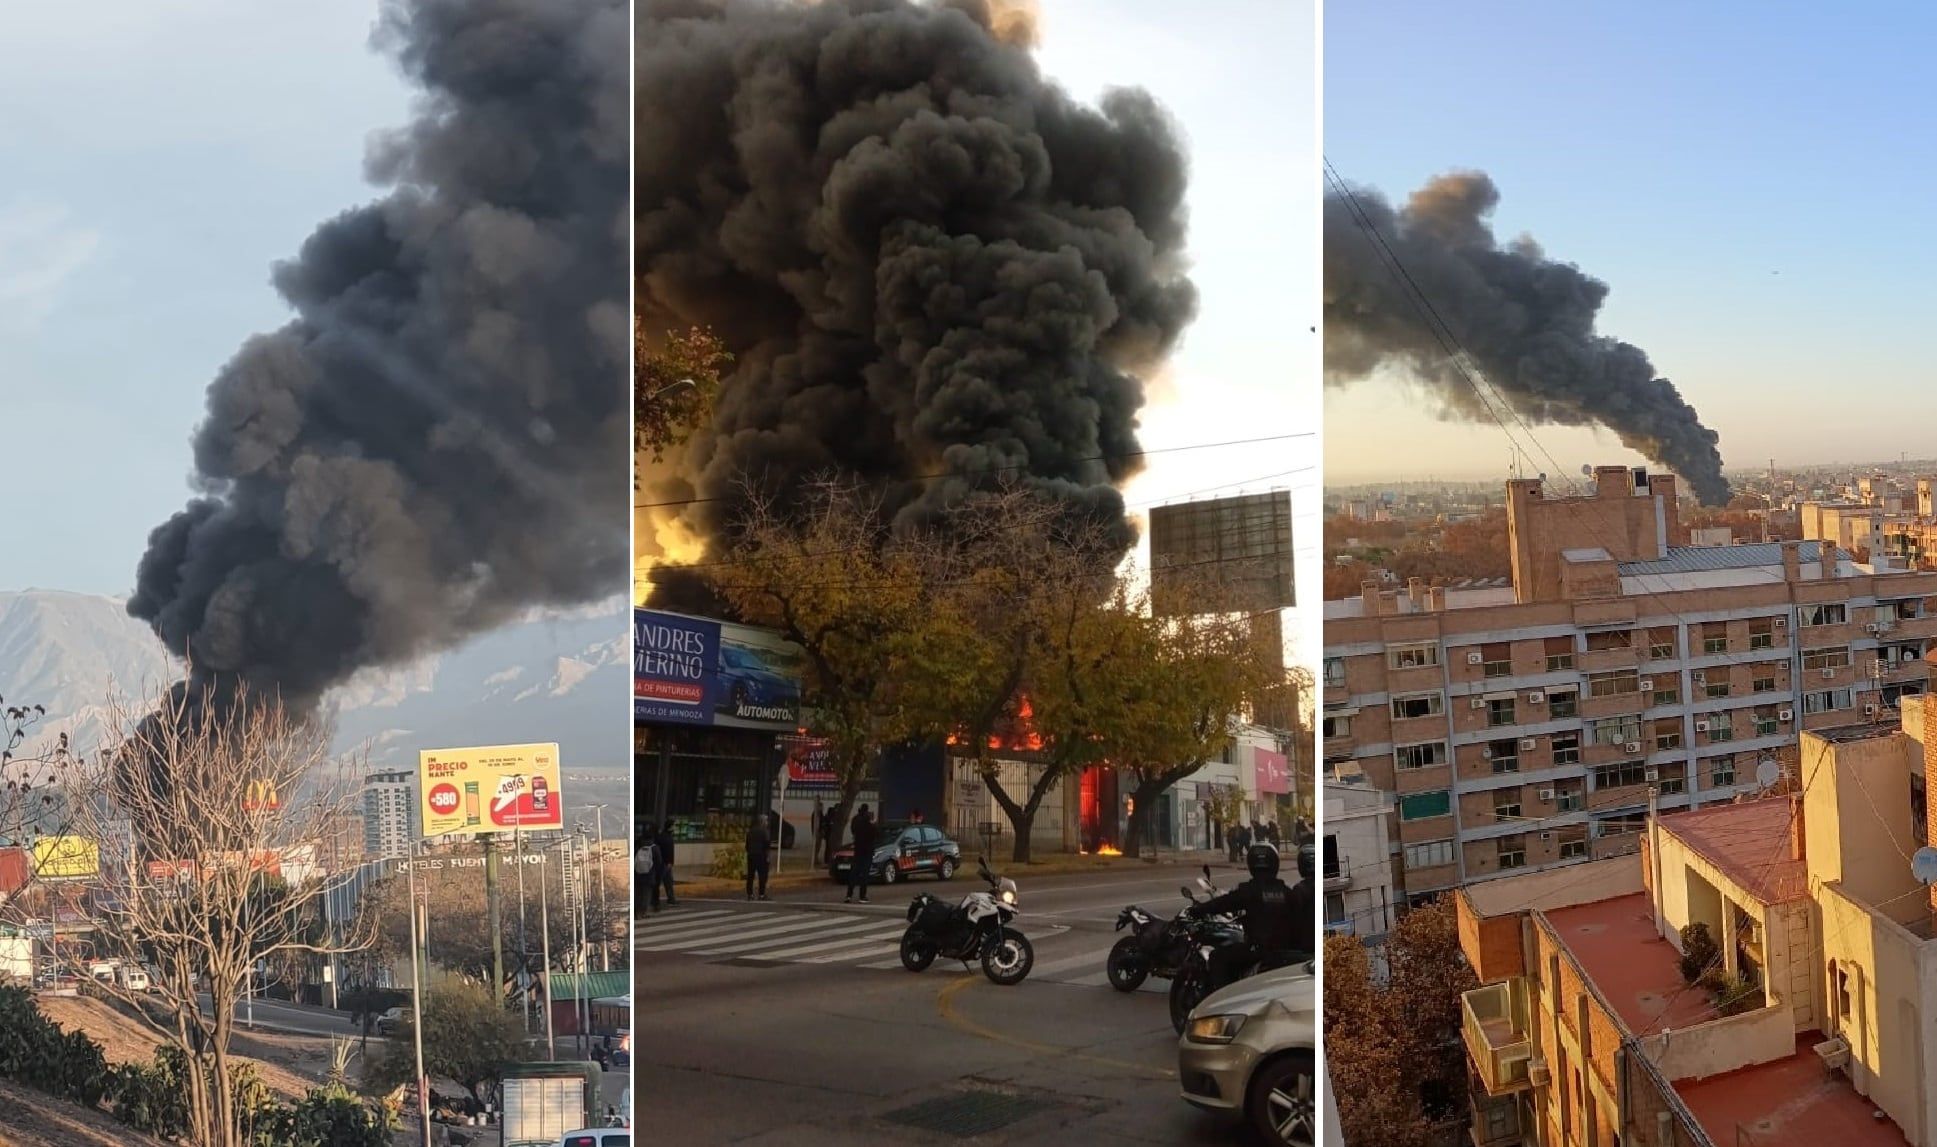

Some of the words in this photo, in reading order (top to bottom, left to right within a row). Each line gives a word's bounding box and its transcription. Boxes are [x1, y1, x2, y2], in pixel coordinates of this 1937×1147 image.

[634, 622, 704, 655] ANDRES
[644, 683, 655, 693] DE
[634, 705, 656, 715] ERIAS
[669, 707, 703, 720] MENDOZA
[428, 761, 468, 772] PRECIO
[429, 770, 455, 778] NANTE
[451, 857, 487, 868] FUENT
